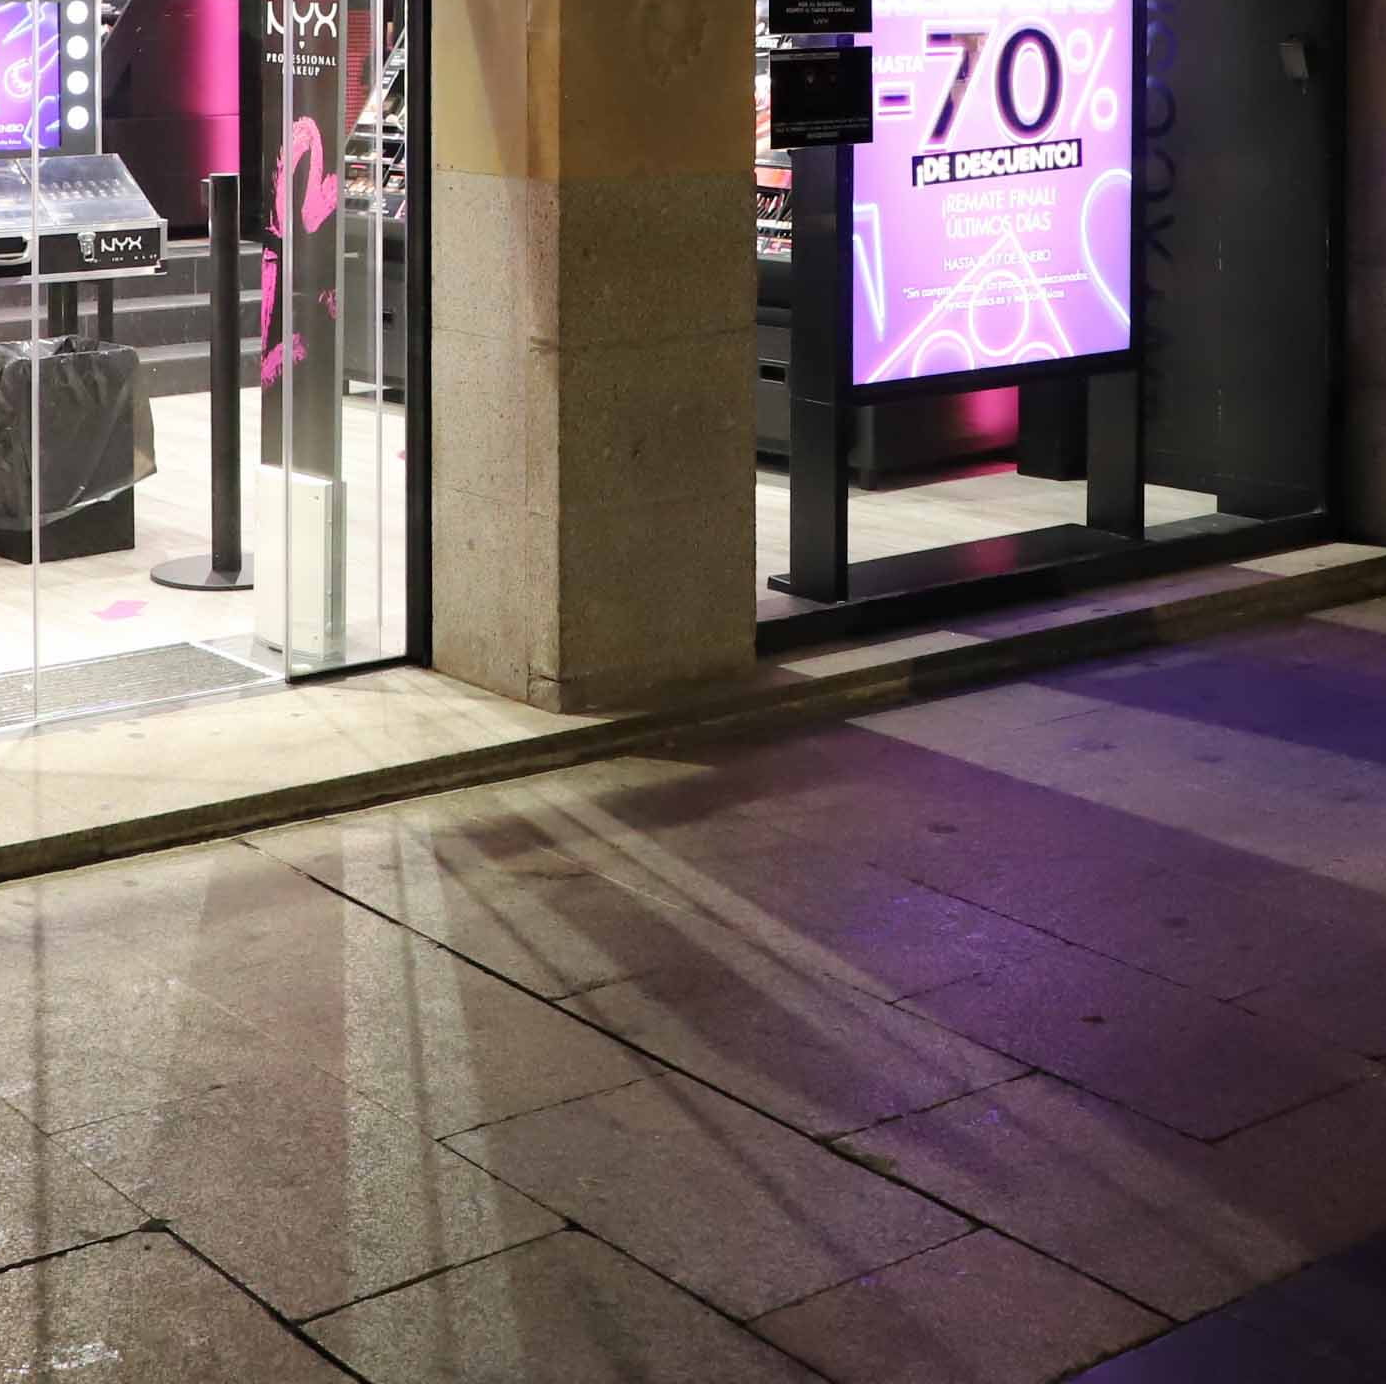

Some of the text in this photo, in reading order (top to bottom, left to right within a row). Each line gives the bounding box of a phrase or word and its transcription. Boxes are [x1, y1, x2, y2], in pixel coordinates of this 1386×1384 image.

[916, 141, 1079, 189] ¡DE DESCUENTO!
[941, 182, 1057, 217] ¡REMATE FINAL!
[945, 207, 1053, 240] ÚLTIMOS DÍAS
[100, 236, 142, 253] NYX
